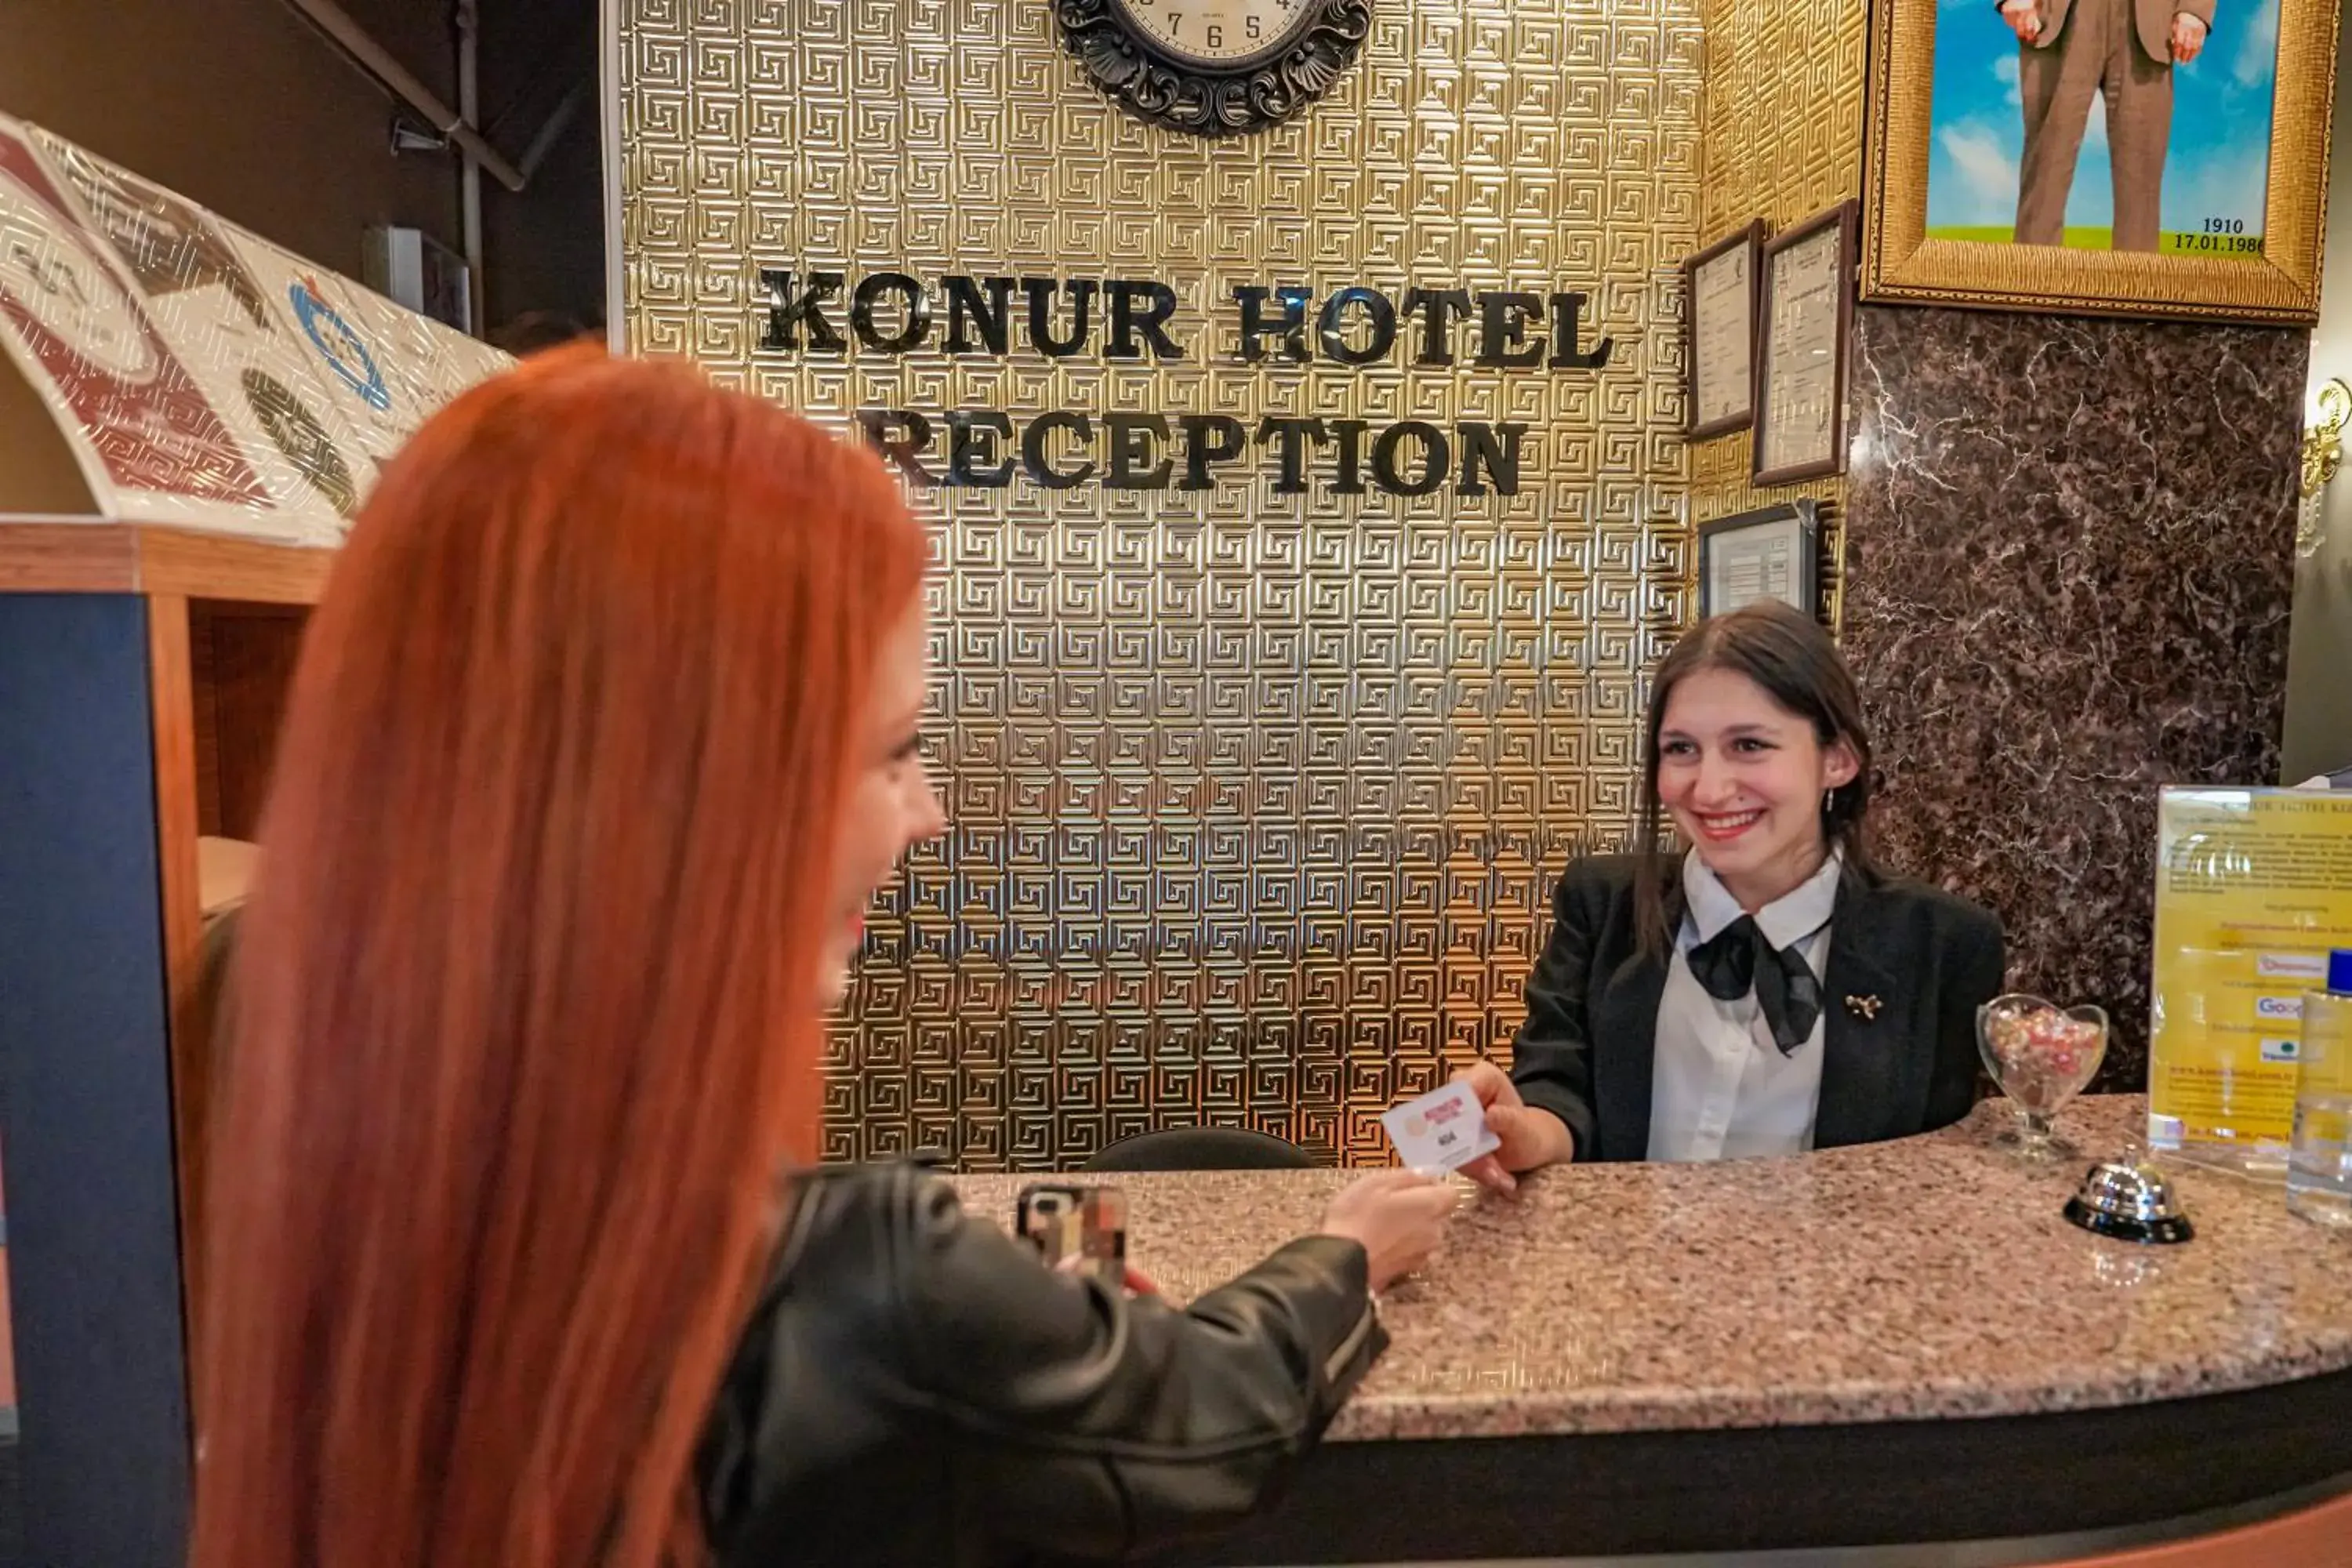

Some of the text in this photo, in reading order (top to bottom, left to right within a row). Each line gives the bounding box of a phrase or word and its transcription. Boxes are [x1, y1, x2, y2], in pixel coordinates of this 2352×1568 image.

[1168, 13, 1182, 35] 7
[1246, 16, 1259, 38] 5
[1207, 25, 1222, 48] 6
[2204, 217, 2243, 234] 1910
[760, 270, 1185, 358] KONUR
[1233, 286, 1613, 369] HOTEL
[857, 409, 1528, 495] RECEPTION
